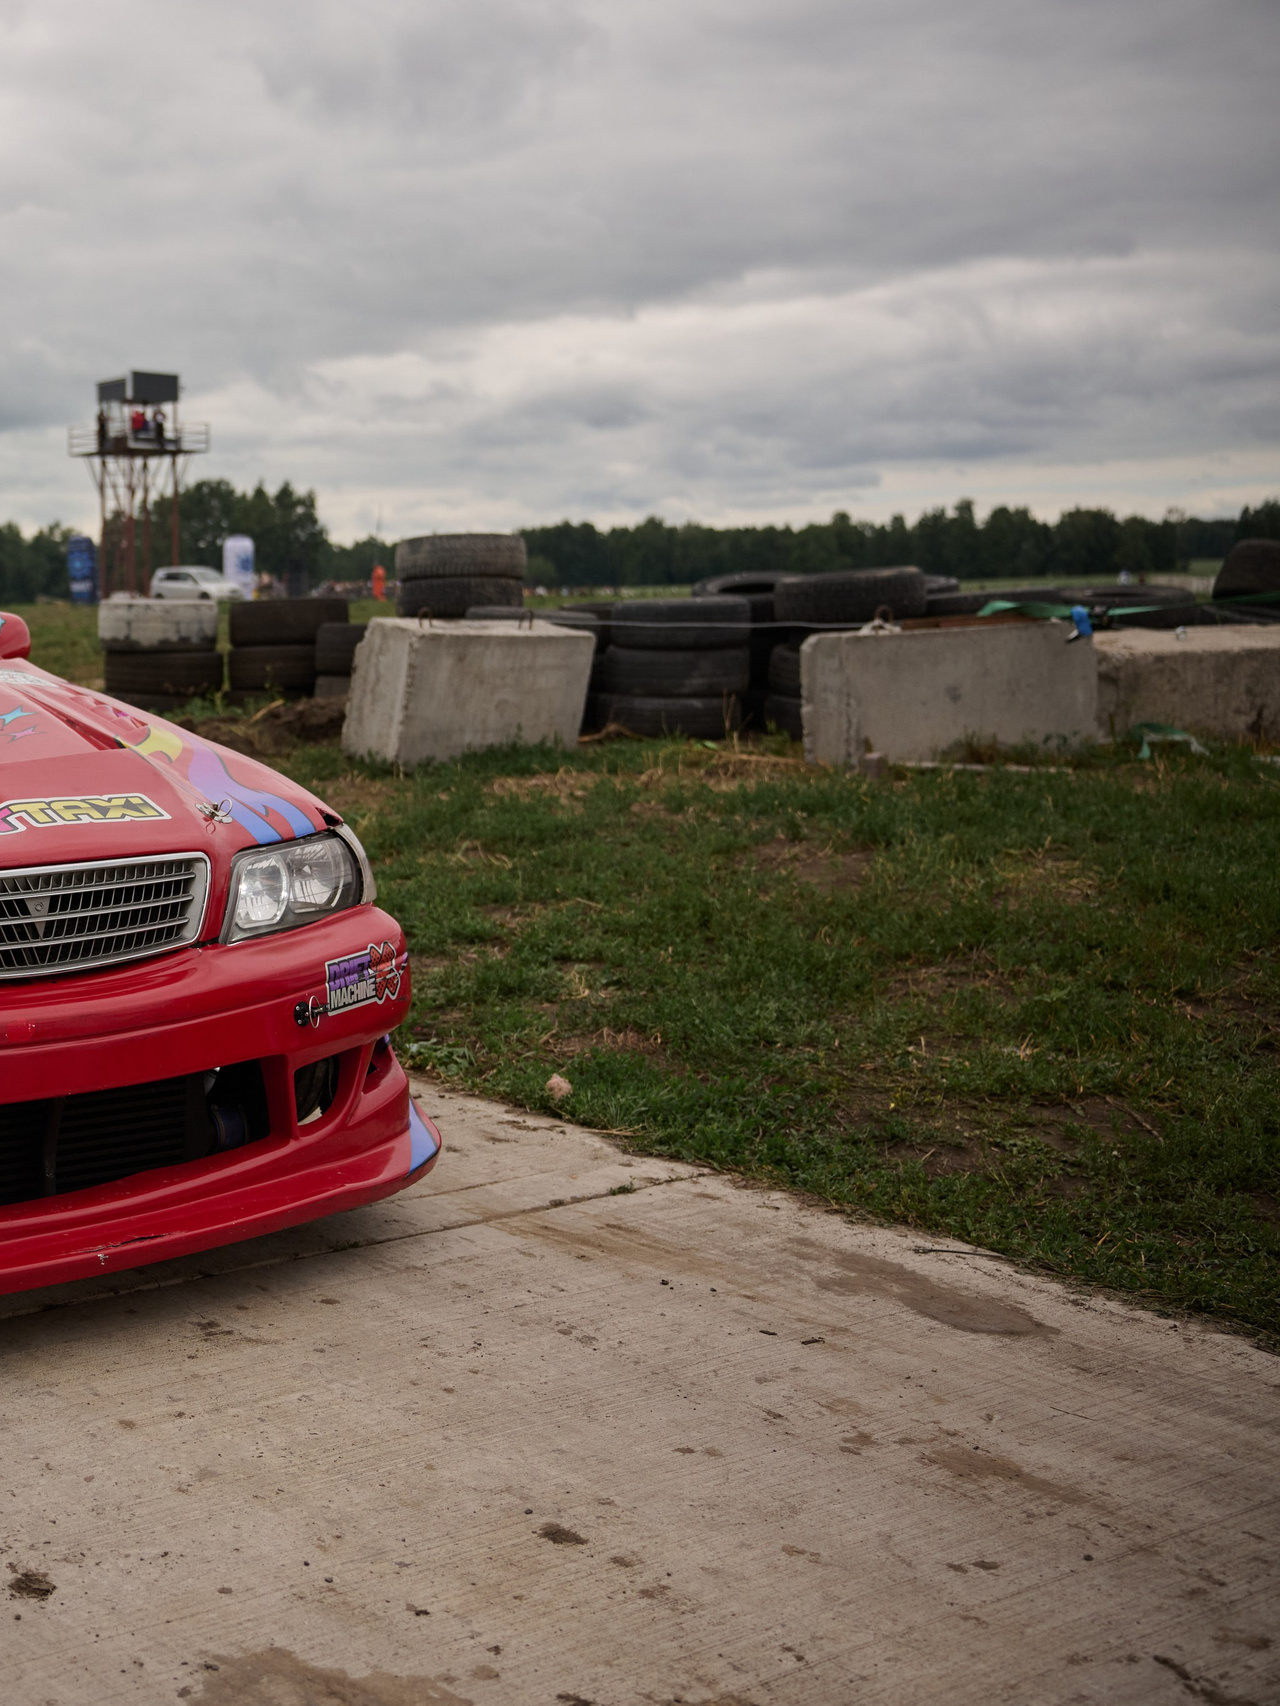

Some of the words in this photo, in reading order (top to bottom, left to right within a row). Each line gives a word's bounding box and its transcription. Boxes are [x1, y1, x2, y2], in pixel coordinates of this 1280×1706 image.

[9, 796, 161, 824] TAXI
[329, 954, 371, 991] DRIFT
[330, 978, 376, 1009] MACHINE
